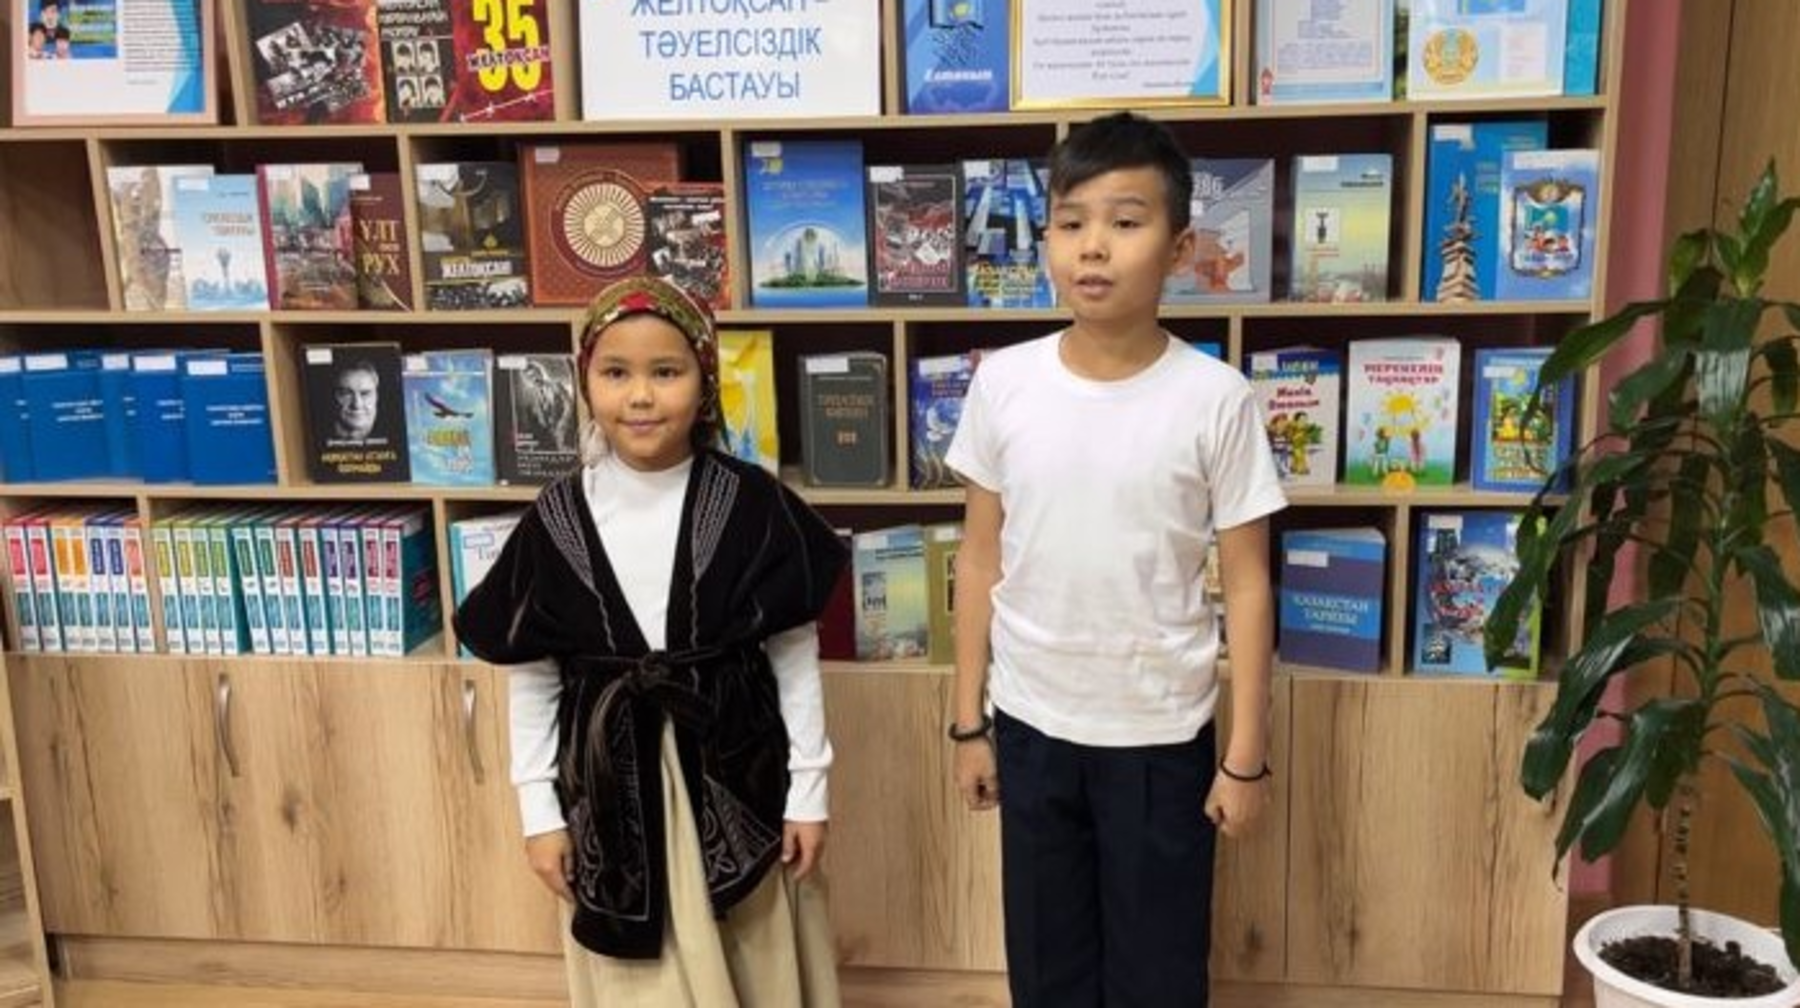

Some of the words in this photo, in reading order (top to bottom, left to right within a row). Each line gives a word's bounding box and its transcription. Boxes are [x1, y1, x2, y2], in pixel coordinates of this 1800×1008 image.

[471, 0, 543, 92] 35
[638, 27, 823, 60] ТӘУЕЛСІЗДІК
[669, 71, 801, 102] БАСТАУЫ
